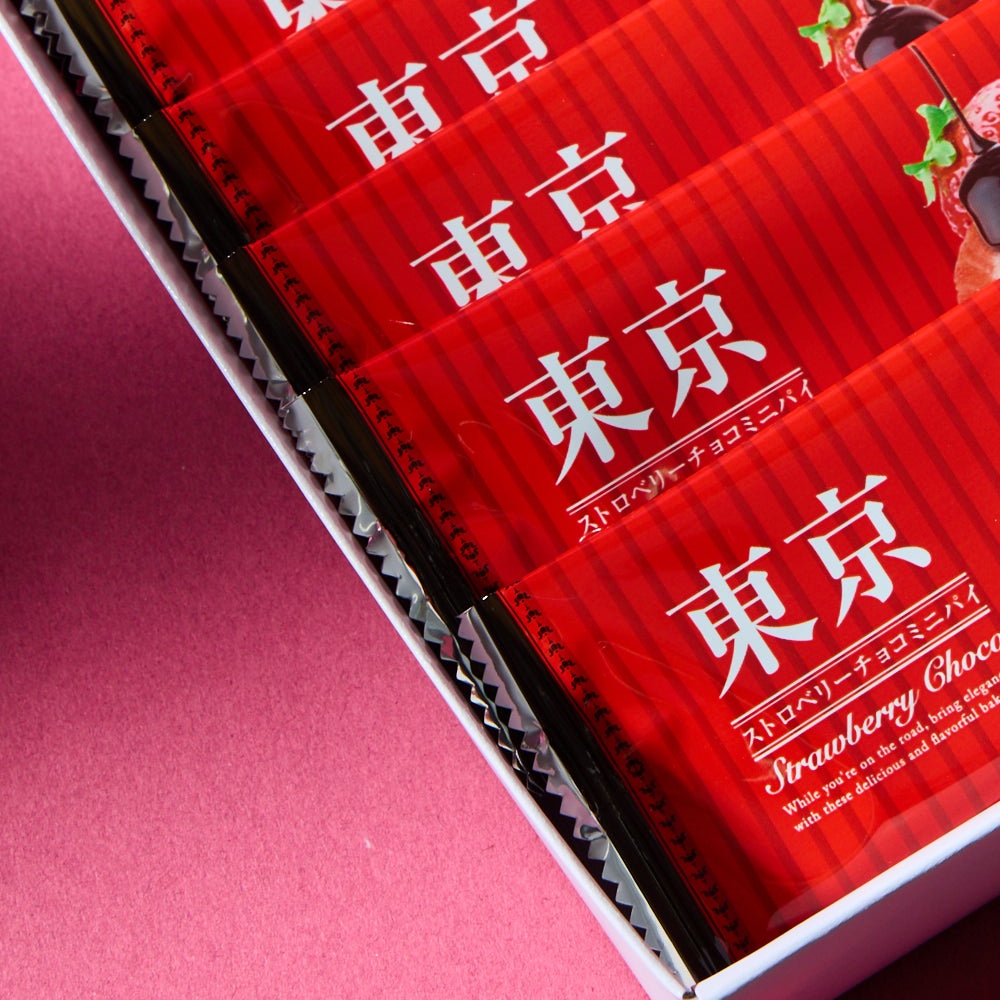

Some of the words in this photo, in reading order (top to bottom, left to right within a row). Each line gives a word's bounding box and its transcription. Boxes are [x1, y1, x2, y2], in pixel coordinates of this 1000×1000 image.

[410, 131, 646, 307] 東京
[504, 268, 768, 486] 東京
[577, 379, 813, 542] ストロベリーチョコミニパイ
[666, 475, 933, 699] 東京
[743, 584, 980, 749] ストロベリーチョコミニパイ
[764, 688, 920, 795] Strawberry
[782, 791, 821, 816] While
[821, 767, 858, 797] you're
[859, 756, 876, 770] on
[876, 742, 897, 758] the
[898, 720, 930, 745] road,
[927, 700, 964, 725] bring
[793, 811, 822, 832] with
[822, 792, 854, 815] these
[855, 758, 907, 795] delicious
[907, 739, 930, 761] and
[930, 707, 980, 746] flavorful
